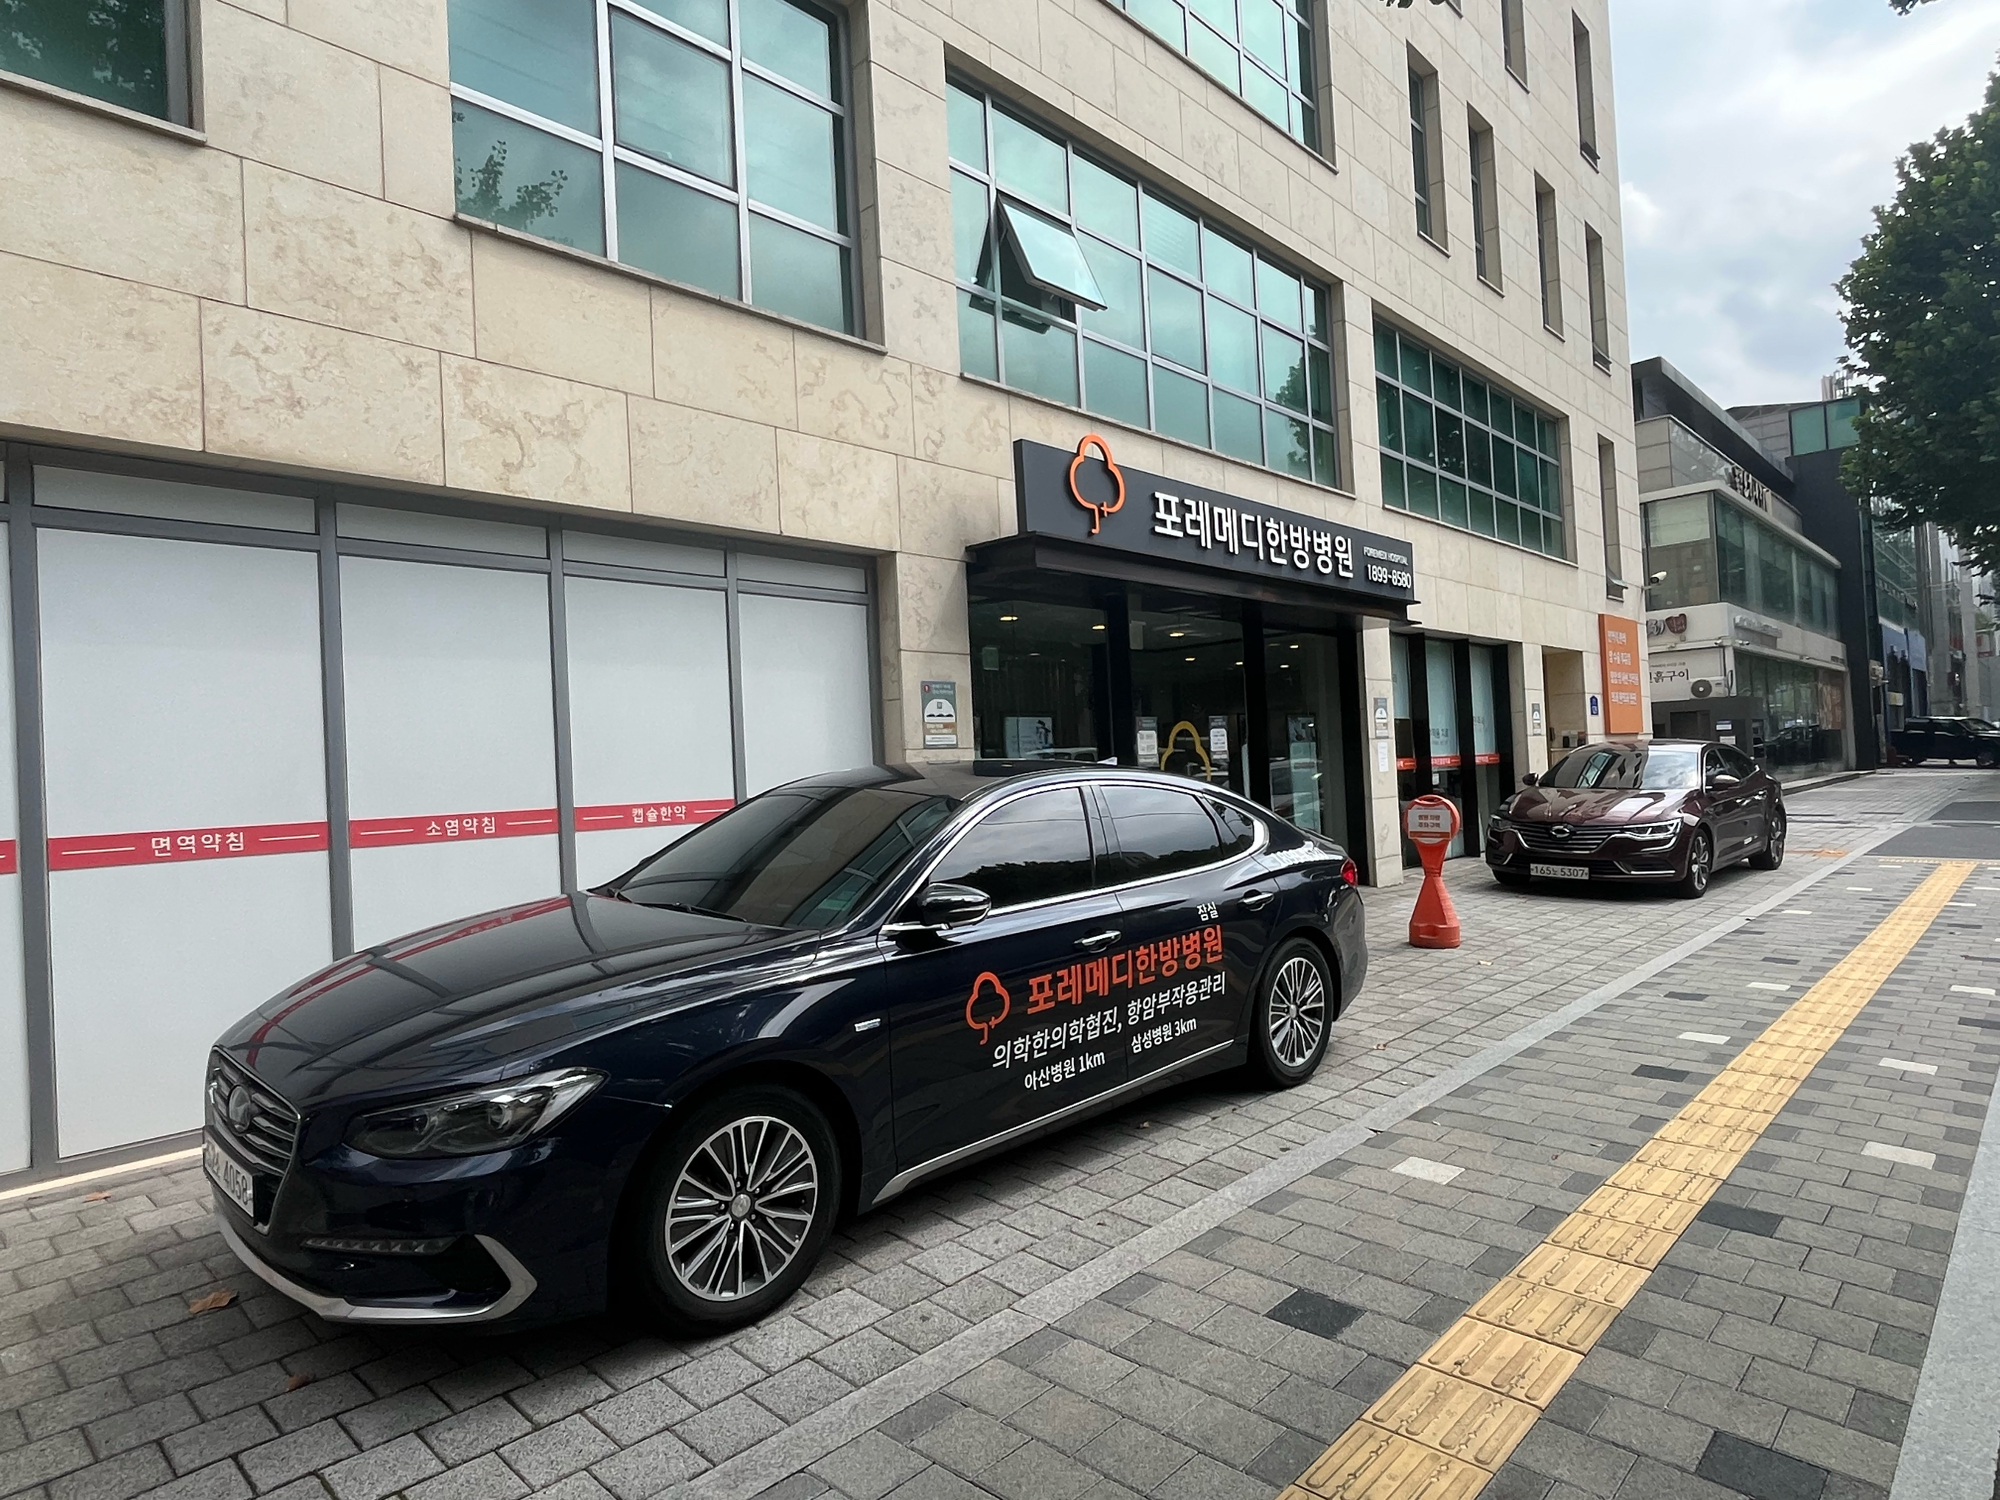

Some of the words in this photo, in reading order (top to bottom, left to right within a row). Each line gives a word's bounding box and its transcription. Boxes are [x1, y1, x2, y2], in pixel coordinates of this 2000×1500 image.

[1153, 491, 1354, 579] 포레메디한방병원
[1367, 564, 1411, 588] 1899-8580
[425, 816, 495, 836] 소염약침
[632, 805, 686, 823] 캡슐한약
[151, 832, 244, 857] 면역약침
[1560, 867, 1584, 878] 5307
[1197, 901, 1218, 921] 잠실
[1027, 924, 1223, 1014] 포레메디한방병원
[992, 1007, 1122, 1069] 의학한의학협진,
[1127, 971, 1226, 1025] 항암부작용관리
[1131, 1022, 1173, 1054] 삼성병원
[1174, 1016, 1197, 1037] 3km
[1024, 1057, 1075, 1091] 아산병원
[1078, 1051, 1105, 1075] 1km
